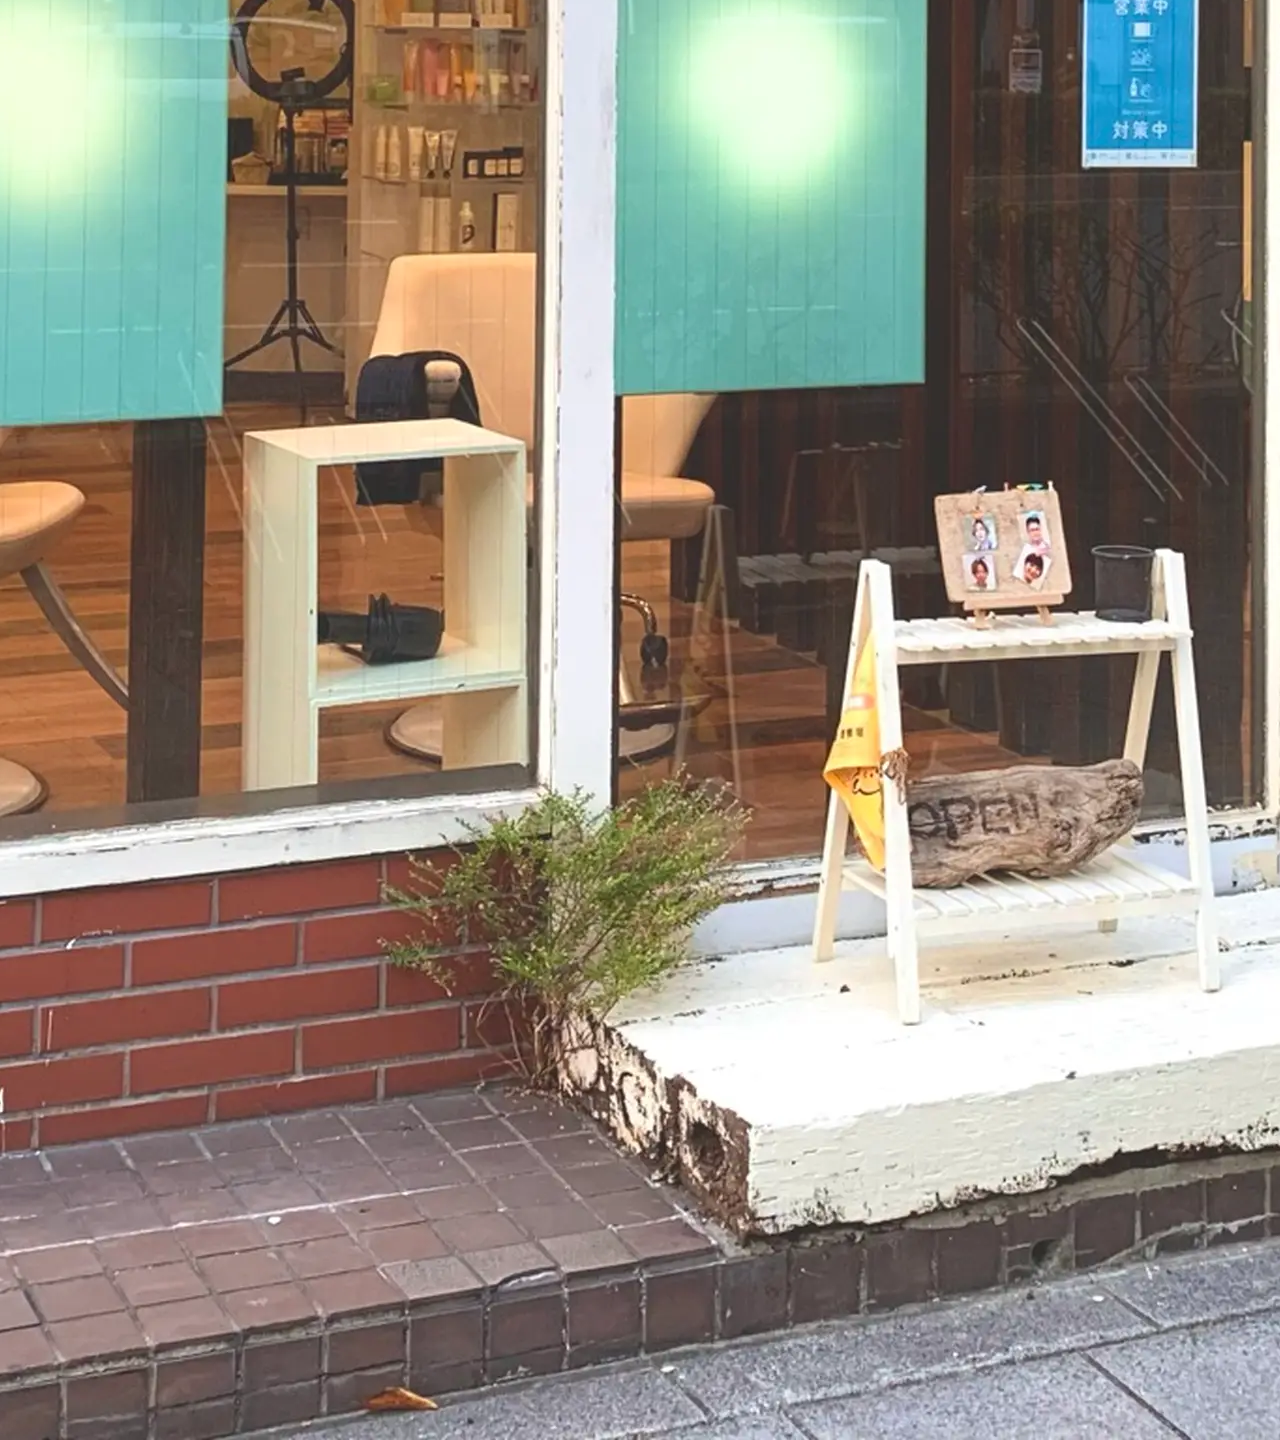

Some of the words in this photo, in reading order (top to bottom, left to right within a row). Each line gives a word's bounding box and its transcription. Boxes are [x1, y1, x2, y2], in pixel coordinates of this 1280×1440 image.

[1112, 120, 1168, 140] 対策中
[908, 793, 1039, 840] OPEN
